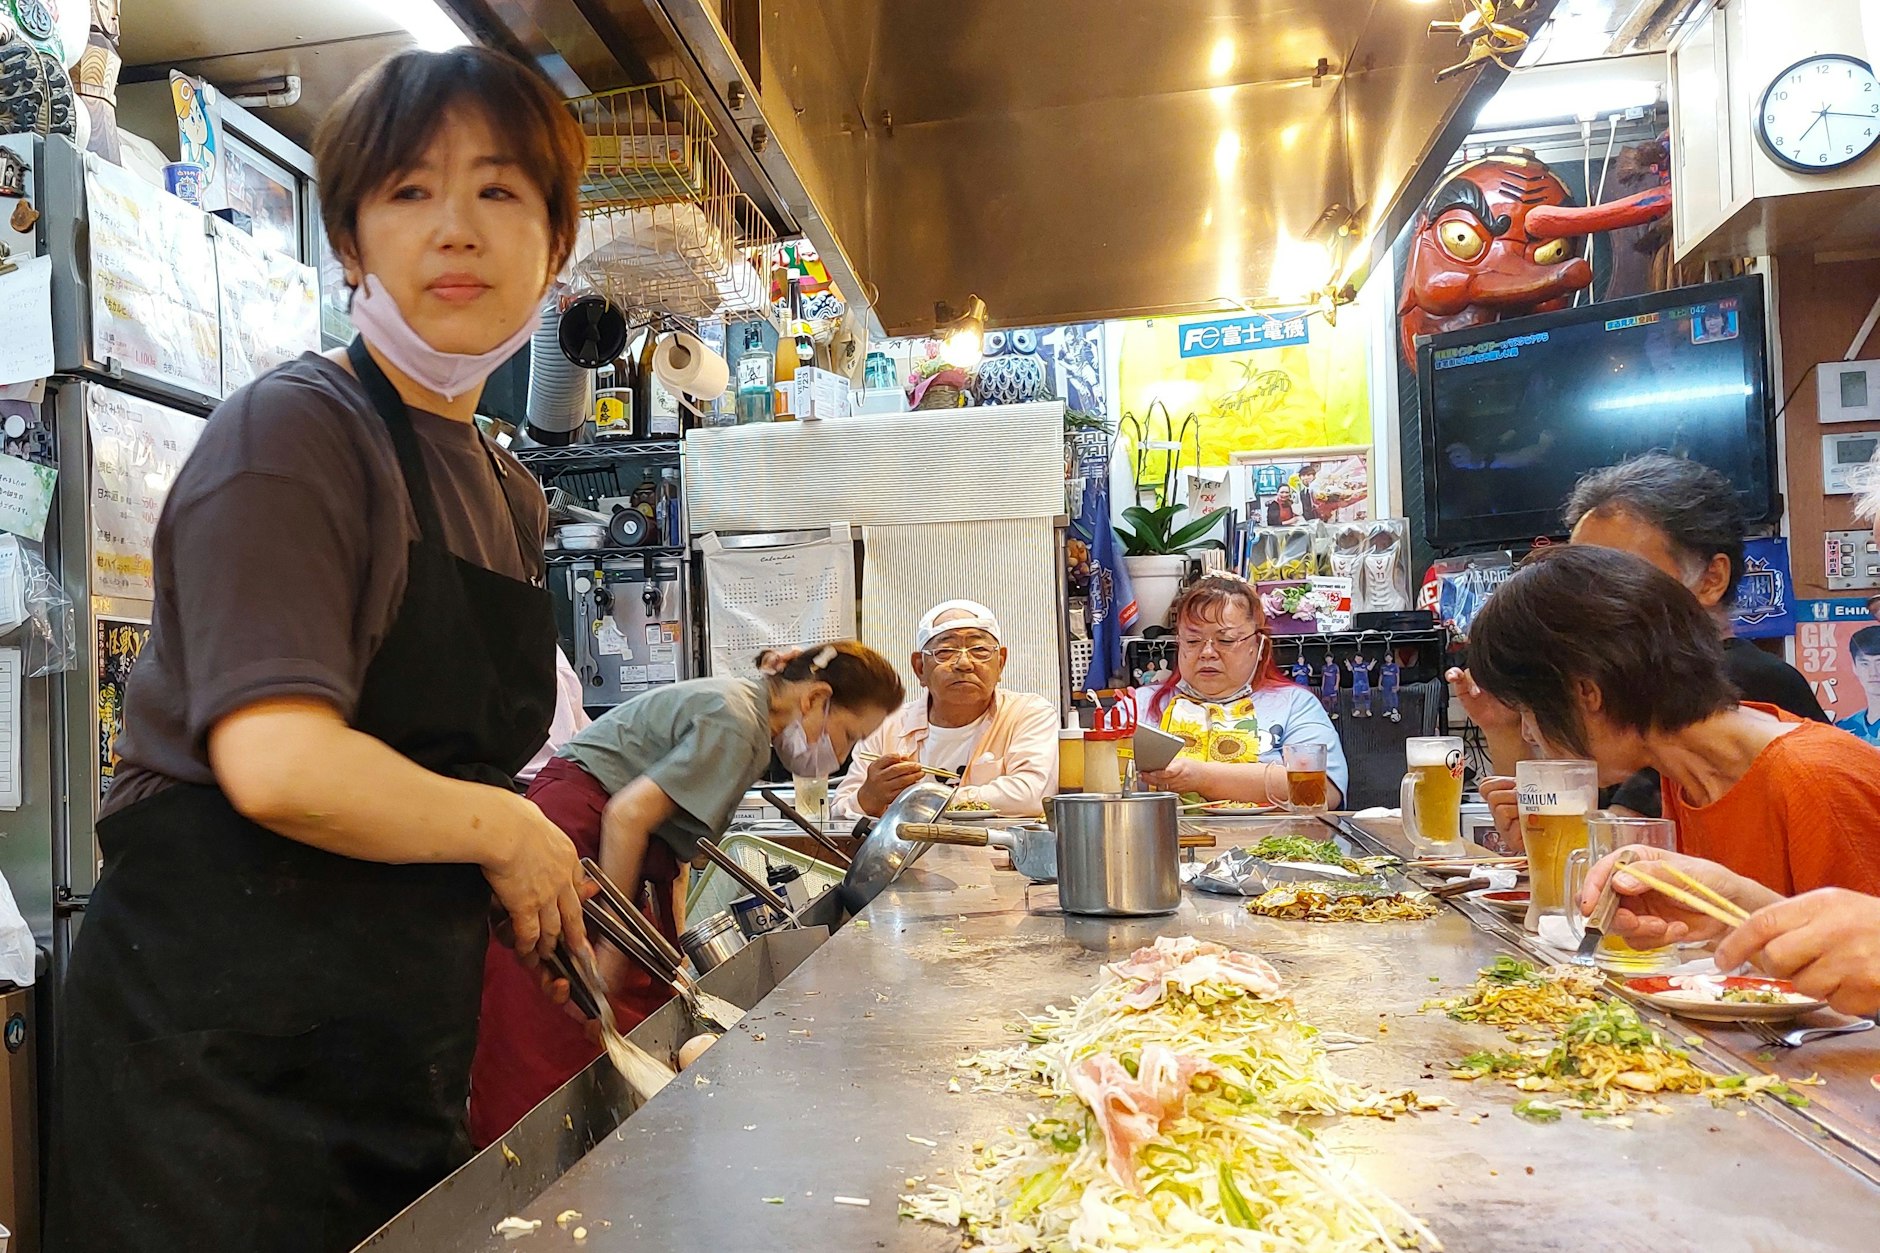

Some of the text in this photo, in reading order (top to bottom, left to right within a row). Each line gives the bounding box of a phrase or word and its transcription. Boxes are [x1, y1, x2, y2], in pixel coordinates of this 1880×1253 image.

[1815, 65, 1829, 74] 12
[1848, 69, 1852, 78] 1
[1791, 75, 1802, 83] 11
[1864, 82, 1872, 92] 2
[1773, 91, 1788, 101] 10
[1871, 104, 1879, 113] 3
[1767, 114, 1775, 124] 9
[1863, 127, 1872, 137] 4
[1775, 136, 1784, 146] 8
[1793, 150, 1801, 159] 7
[1845, 145, 1854, 154] 5
[1819, 153, 1828, 163] 6
[1690, 305, 1706, 315] 042
[1221, 318, 1305, 347] 富士電機
[760, 554, 795, 563] Calendar
[1801, 624, 1838, 648] GK
[1803, 648, 1837, 673] 32
